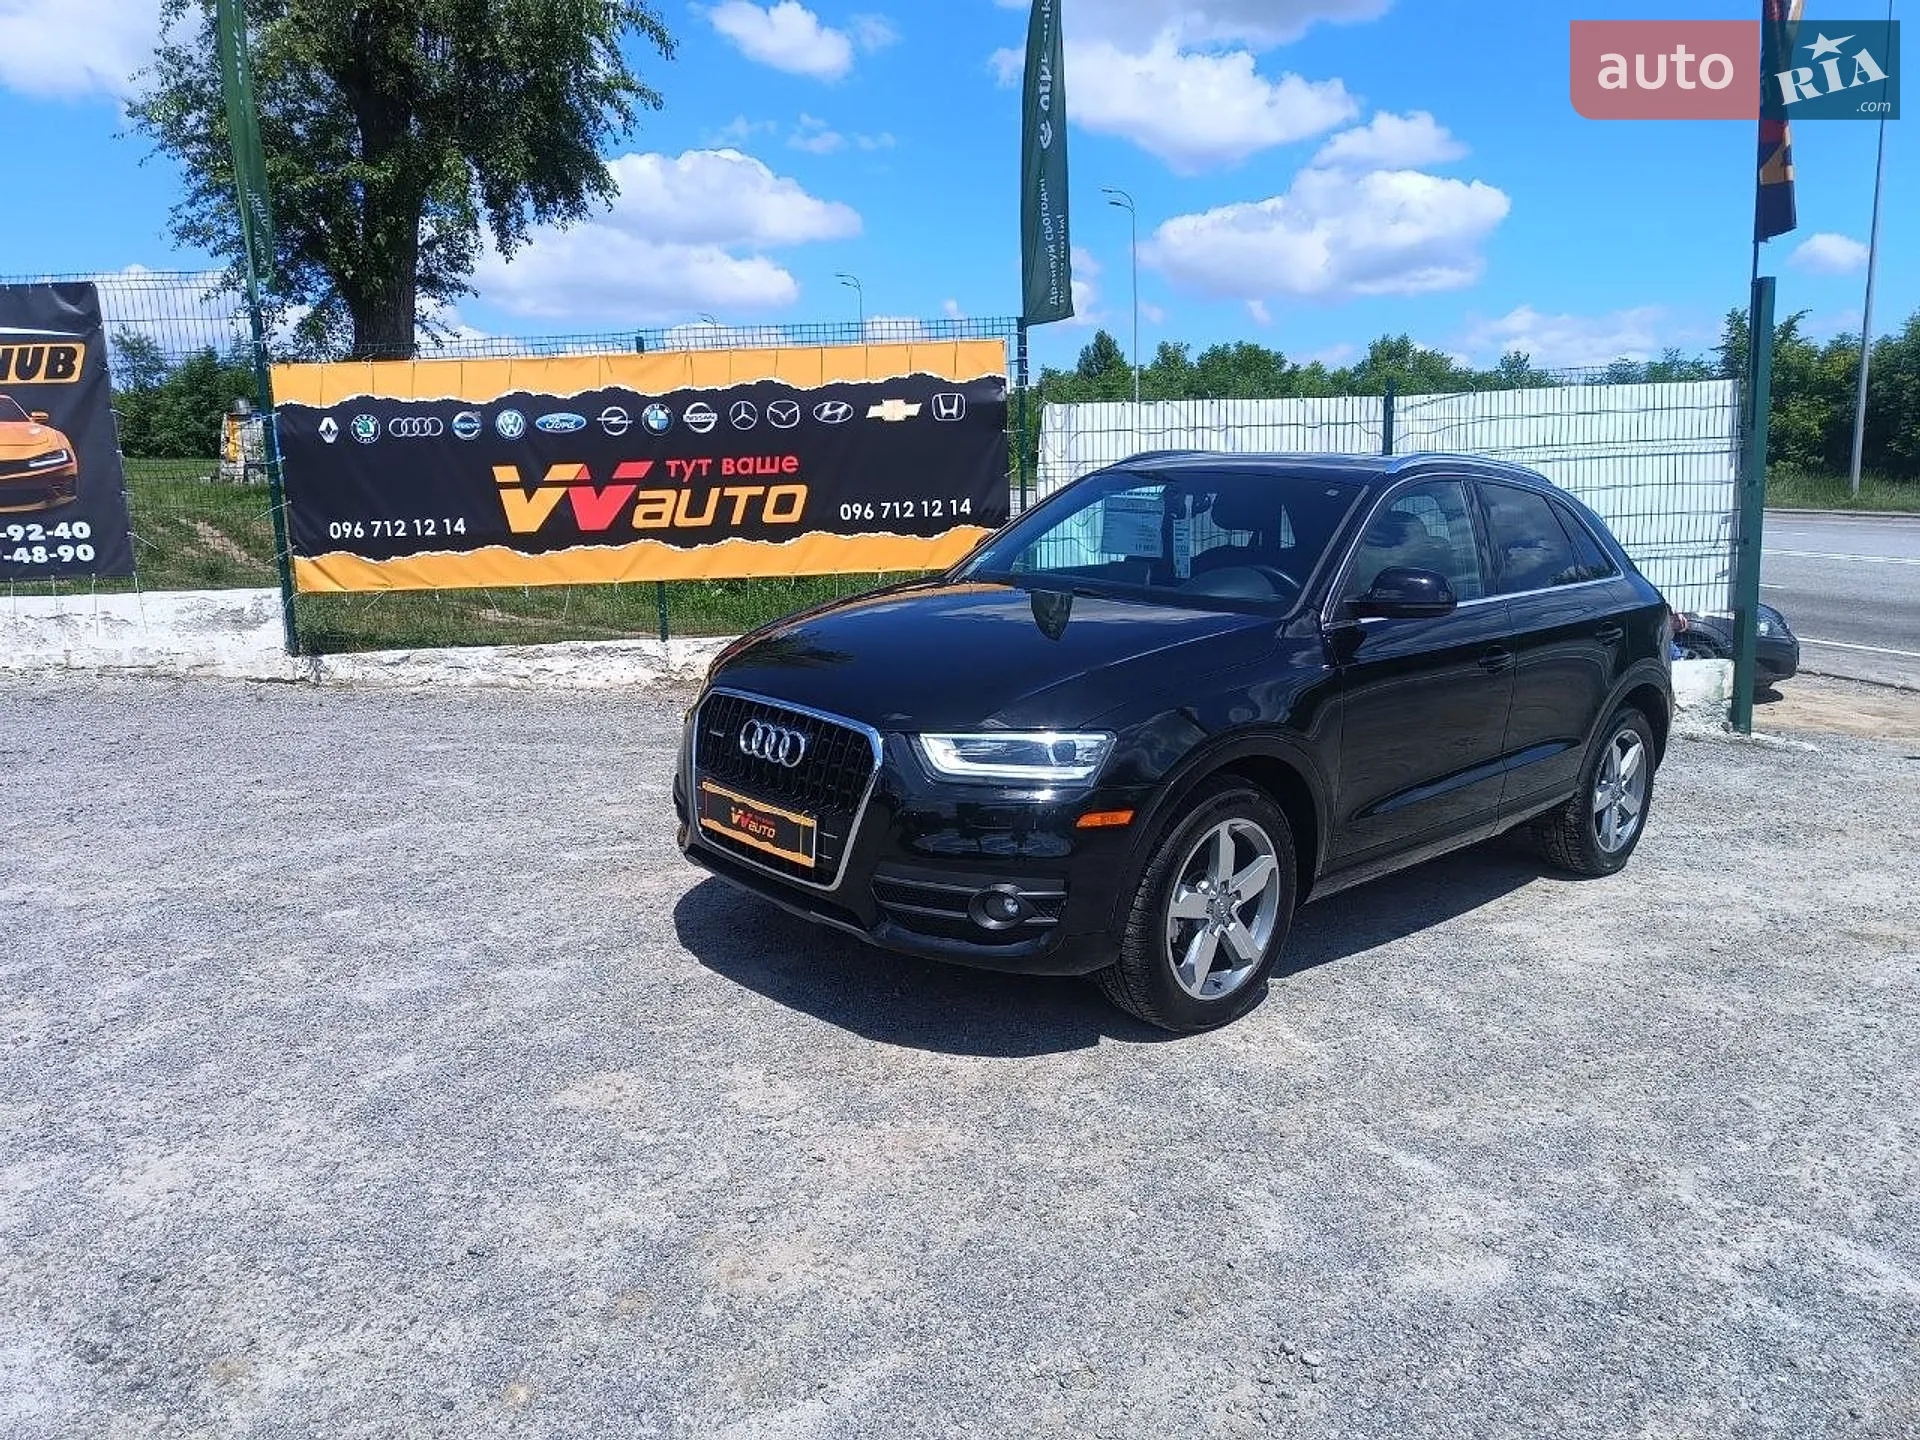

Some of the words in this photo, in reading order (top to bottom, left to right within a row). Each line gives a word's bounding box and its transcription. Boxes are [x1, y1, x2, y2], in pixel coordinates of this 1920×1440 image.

[665, 459, 712, 482] тут
[721, 455, 799, 476] ваше
[840, 503, 875, 520] 096
[880, 501, 915, 519] 712
[921, 499, 944, 517] 12
[949, 498, 972, 516] 14
[329, 521, 364, 539] 096
[370, 520, 407, 537] 712
[413, 519, 437, 536] 12
[443, 517, 466, 535] 14
